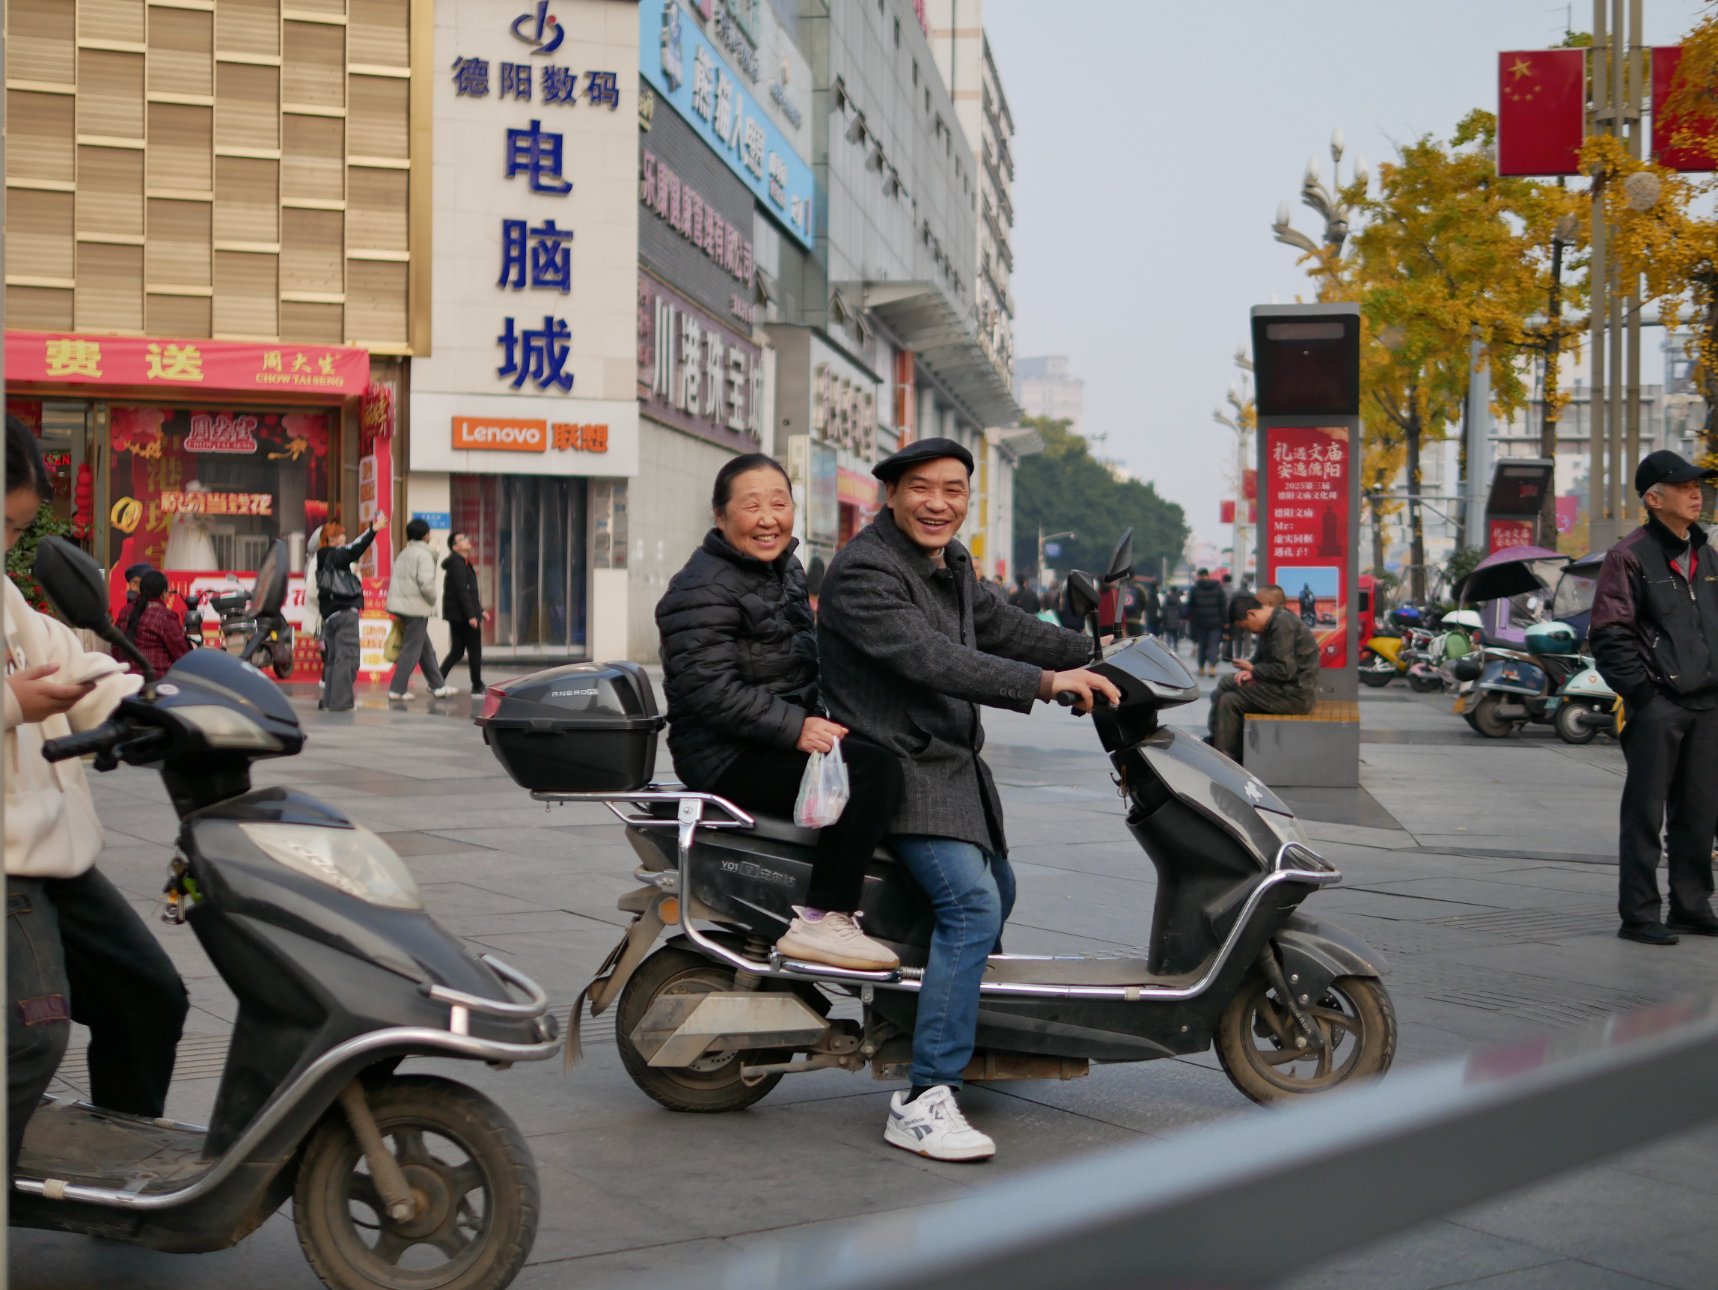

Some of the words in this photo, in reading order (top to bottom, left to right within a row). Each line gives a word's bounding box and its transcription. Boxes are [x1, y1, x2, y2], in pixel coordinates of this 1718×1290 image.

[451, 57, 619, 109] 德阳数码
[498, 119, 574, 392] 电脑城
[263, 351, 335, 375] 周大生
[255, 373, 291, 384] CHOW
[294, 375, 311, 385] TAI
[461, 422, 541, 446] Lenovo
[551, 422, 608, 452] 联想
[1277, 461, 1341, 479] 安逸德阳
